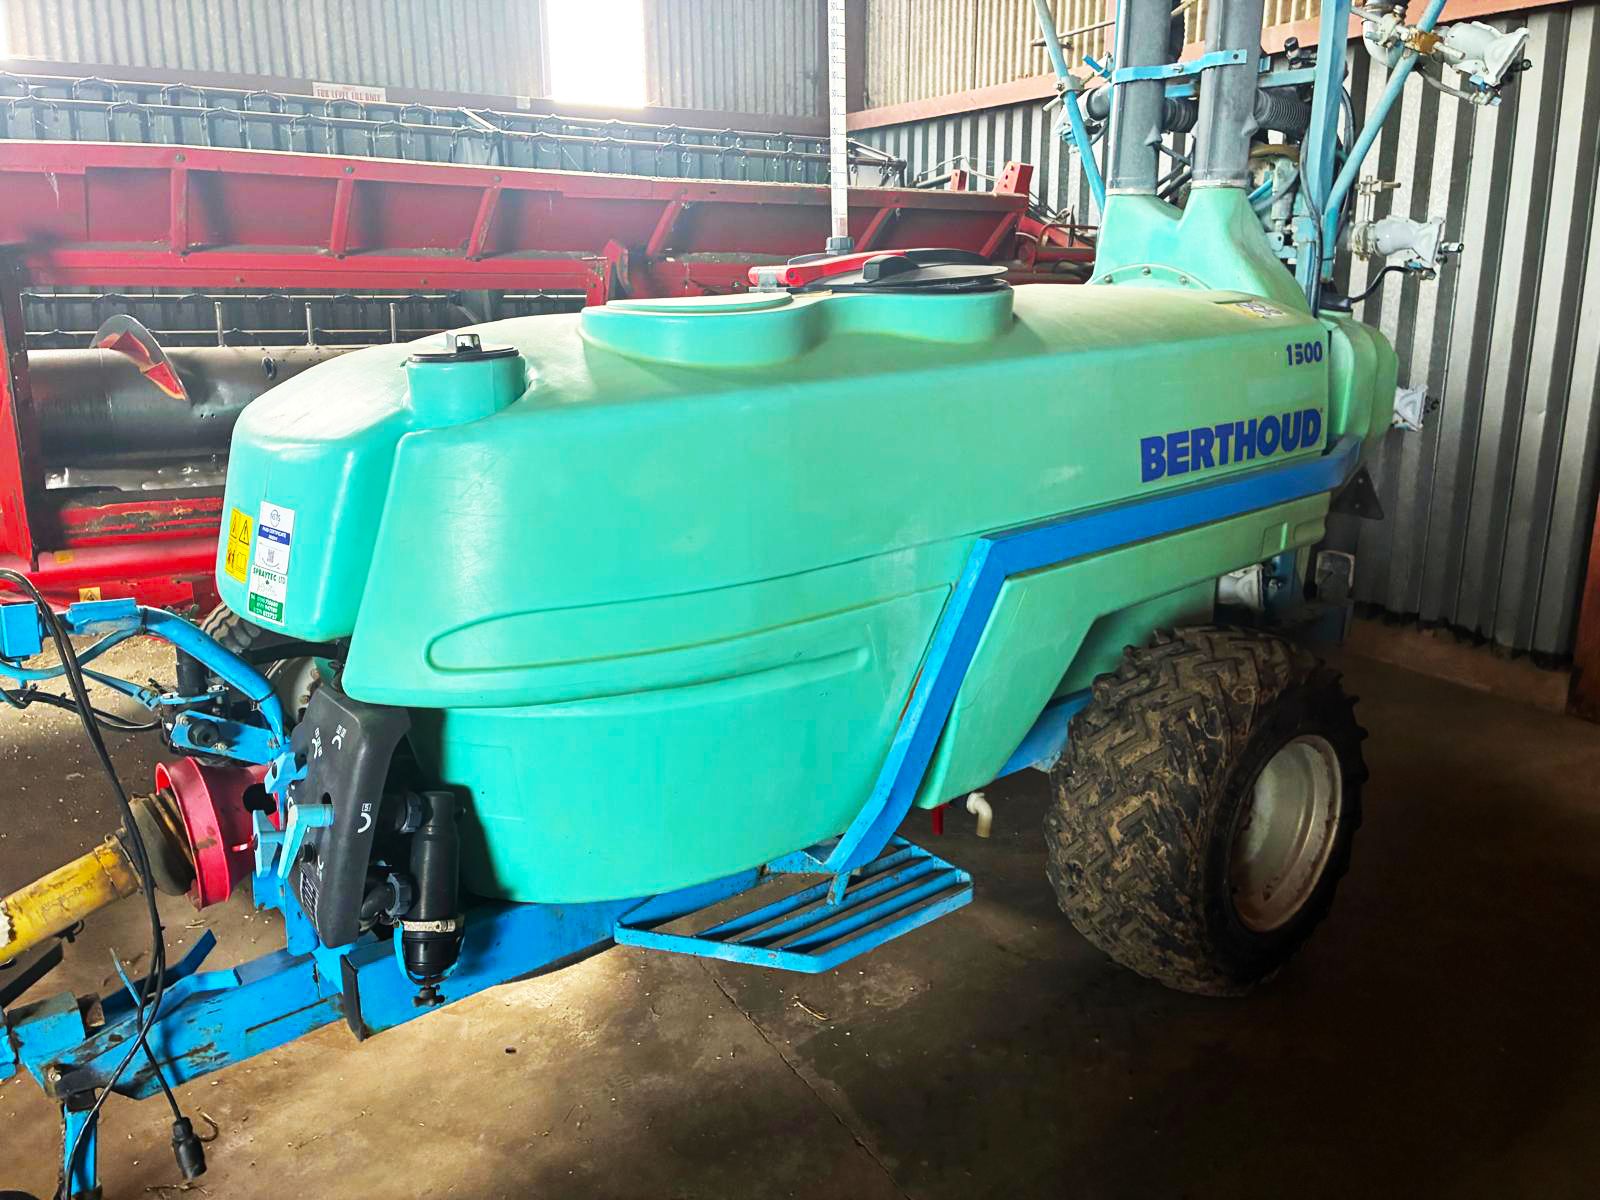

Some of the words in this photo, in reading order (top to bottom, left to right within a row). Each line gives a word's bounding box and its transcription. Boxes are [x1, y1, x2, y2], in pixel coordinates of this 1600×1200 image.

[1286, 341, 1323, 365] 1500
[1140, 408, 1322, 483] BERTHOUD
[253, 567, 277, 581] SPRAYTEC
